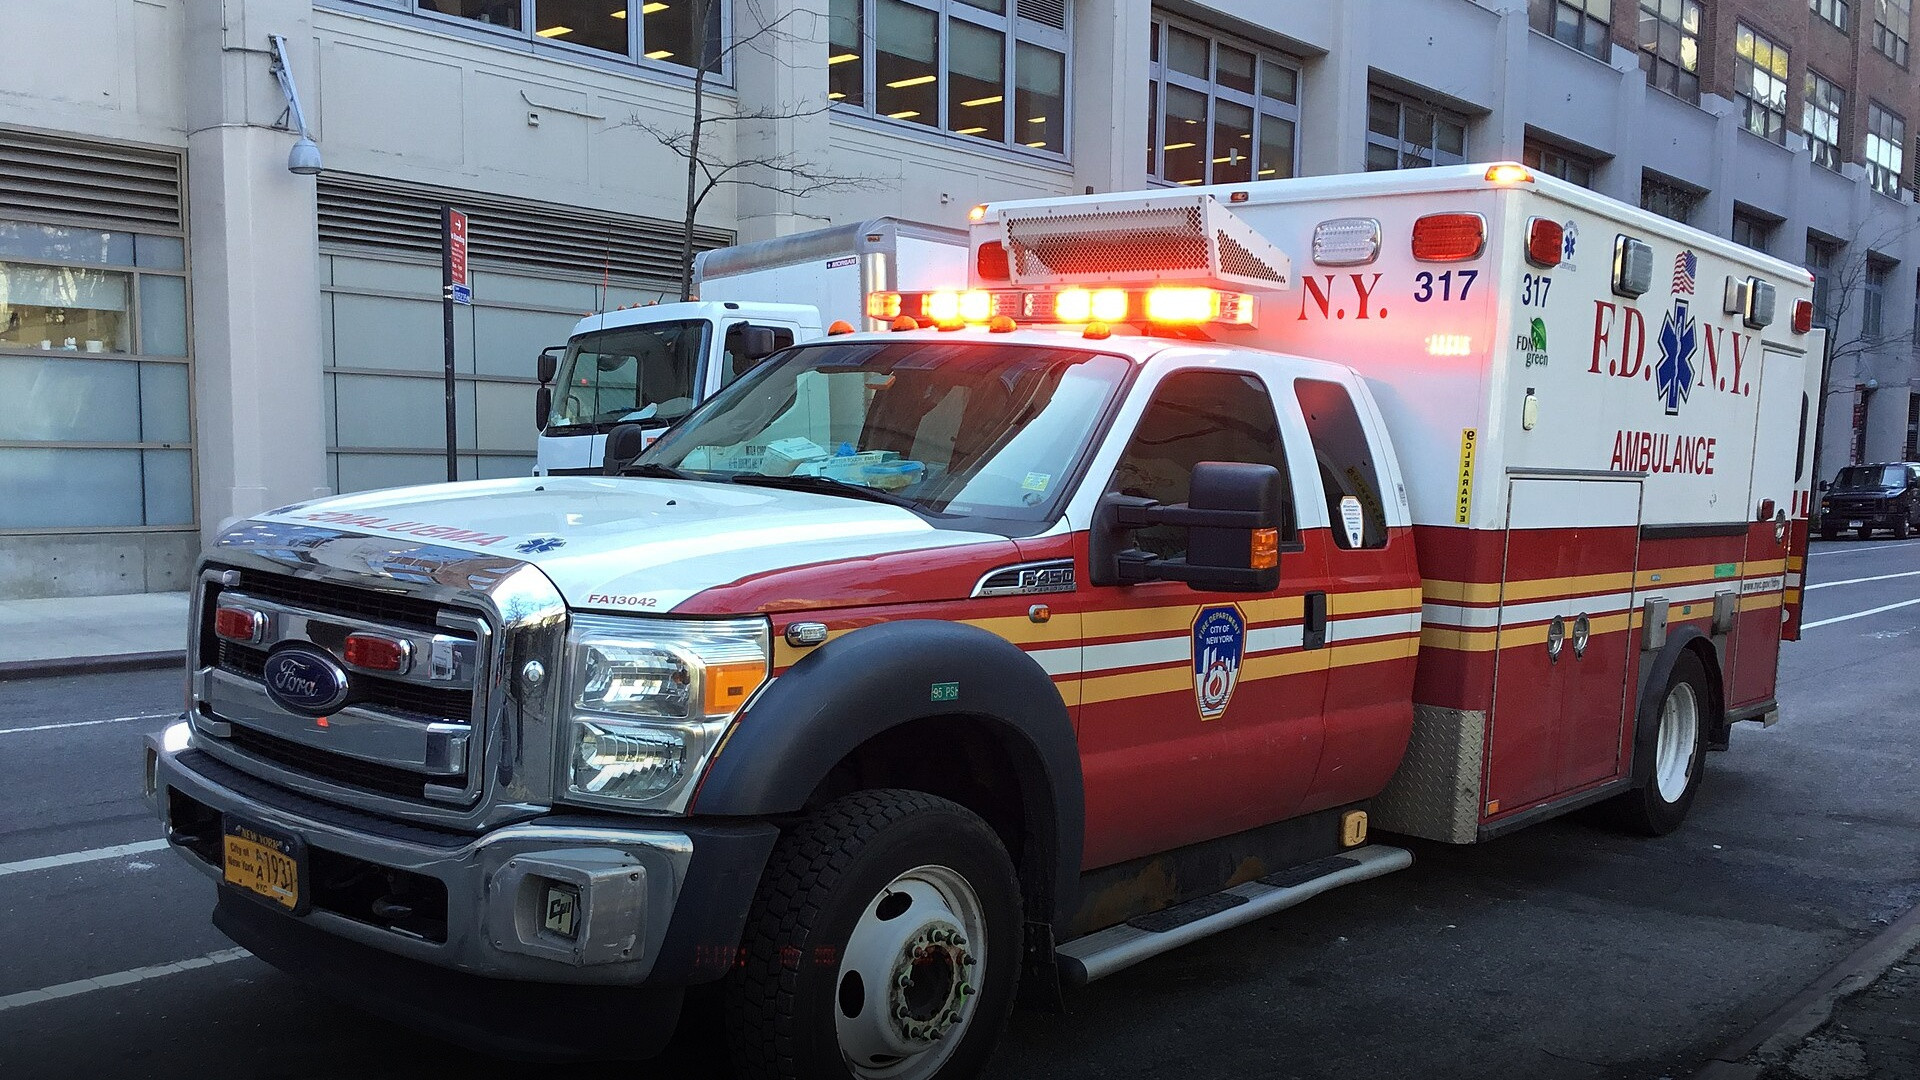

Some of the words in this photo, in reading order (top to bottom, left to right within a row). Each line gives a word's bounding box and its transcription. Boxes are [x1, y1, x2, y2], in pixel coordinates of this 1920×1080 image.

[1297, 272, 1388, 321] N.Y.
[1413, 269, 1479, 303] 317
[1521, 273, 1552, 308] 317
[1516, 334, 1541, 353] FDNY
[1587, 299, 1652, 382] F.D.
[1697, 322, 1752, 398] N.Y.
[1525, 351, 1549, 368] green
[1610, 429, 1717, 475] AMBULANCE
[588, 594, 657, 607] FA13042
[1199, 620, 1209, 640] FIRE
[1208, 612, 1241, 635] DEPARTMENT
[1210, 625, 1222, 634] CITY
[1222, 624, 1230, 633] OF
[1206, 636, 1218, 645] NEW
[1218, 634, 1234, 644] YORK
[275, 658, 319, 697] Ford
[933, 687, 943, 699] 95
[230, 842, 242, 857] City
[242, 829, 257, 842] NEW
[259, 835, 279, 850] YORK
